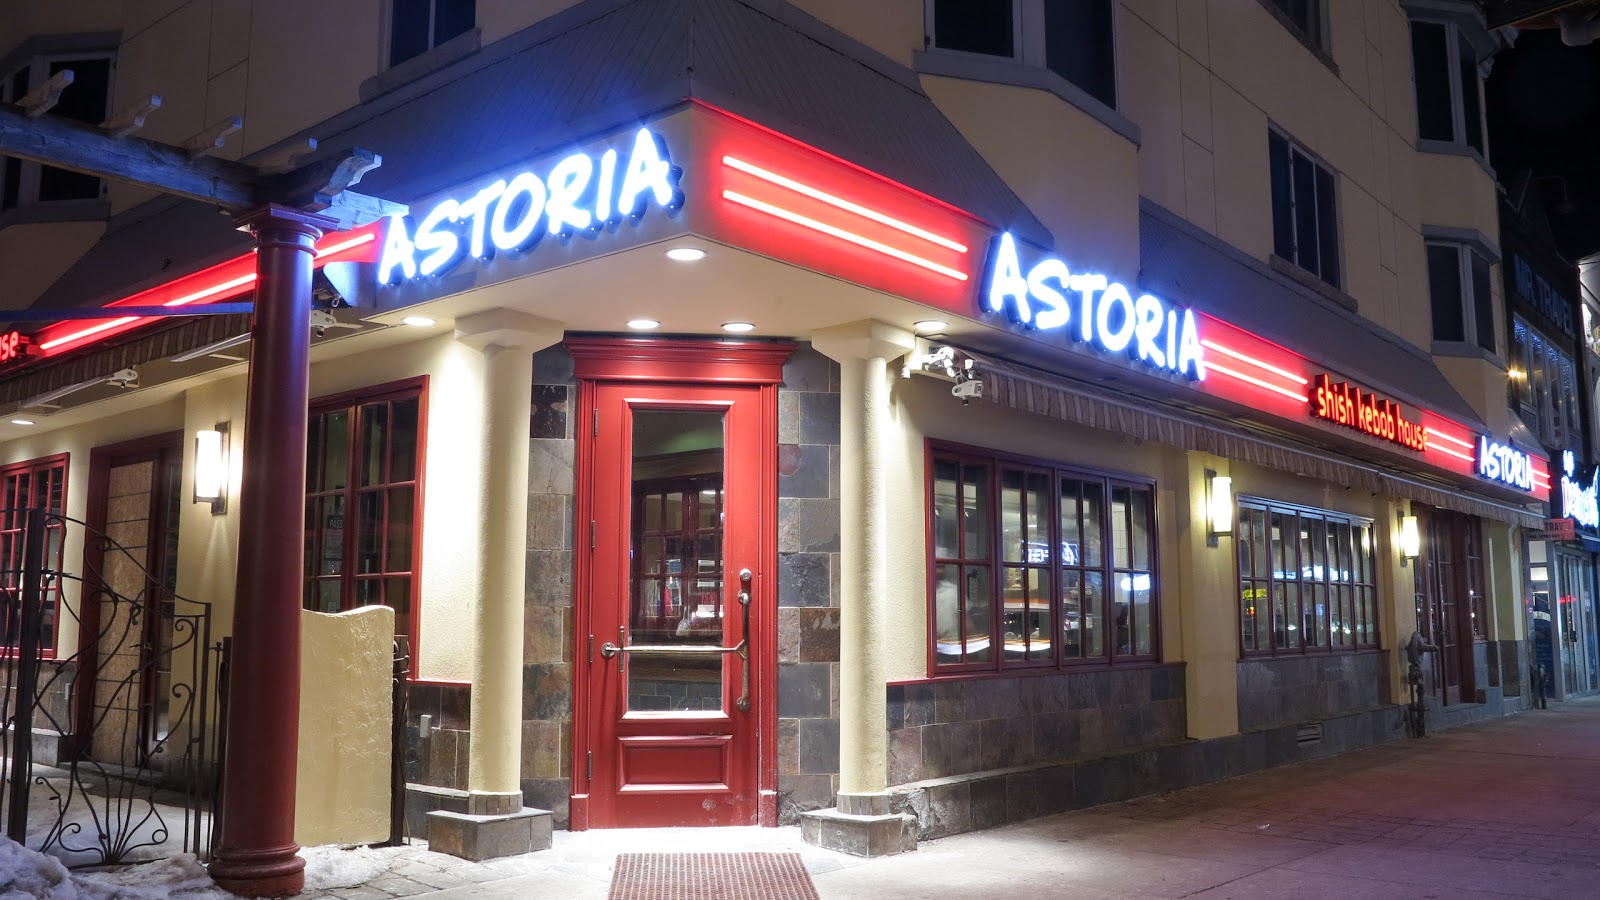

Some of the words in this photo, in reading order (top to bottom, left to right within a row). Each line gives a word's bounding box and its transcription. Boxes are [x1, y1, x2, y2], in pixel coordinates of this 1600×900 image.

[378, 128, 673, 285] ASTORIA
[989, 231, 1206, 381] ASTORIA
[1317, 373, 1354, 426] shish
[1356, 387, 1395, 440] kebob
[1396, 403, 1428, 452] house
[1480, 435, 1535, 491] ASTORIA
